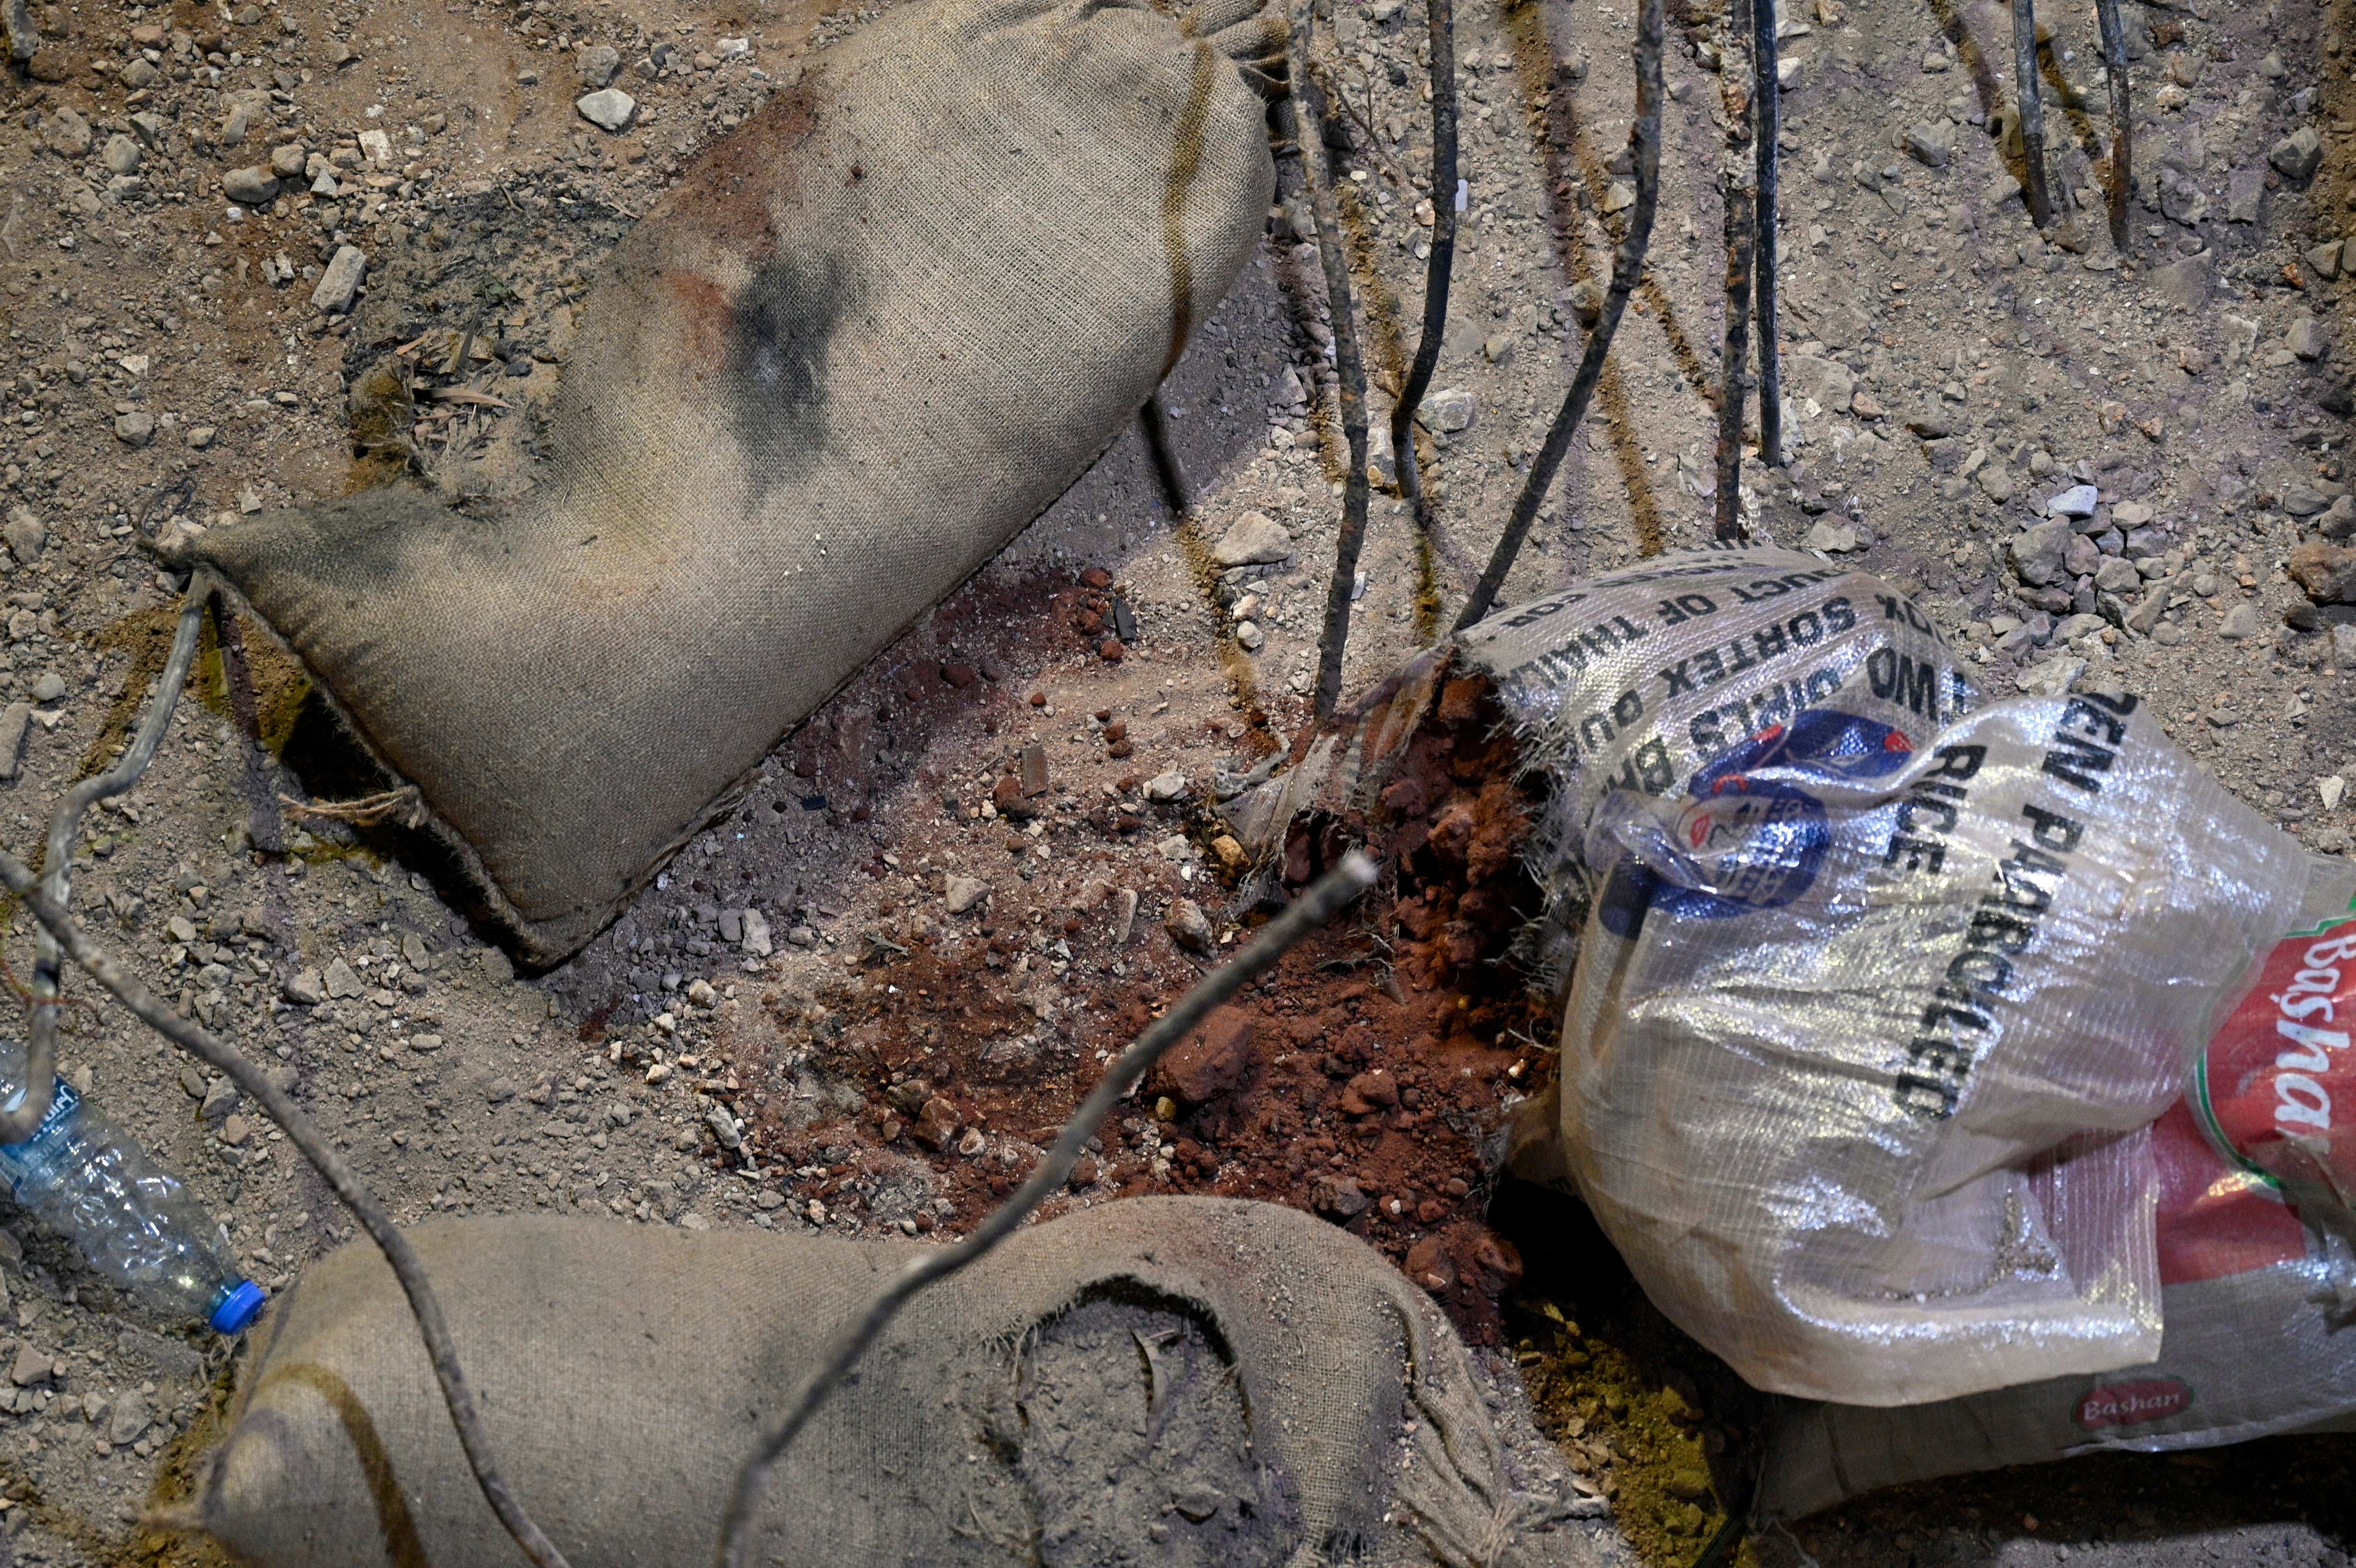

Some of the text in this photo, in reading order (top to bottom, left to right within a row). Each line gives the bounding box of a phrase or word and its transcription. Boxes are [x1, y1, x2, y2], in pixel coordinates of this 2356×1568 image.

[1657, 594, 1717, 626] OF
[1659, 597, 1856, 700] SORTEX
[1883, 745, 1987, 874] RICE
[1896, 804, 2083, 1122] PARBOILED
